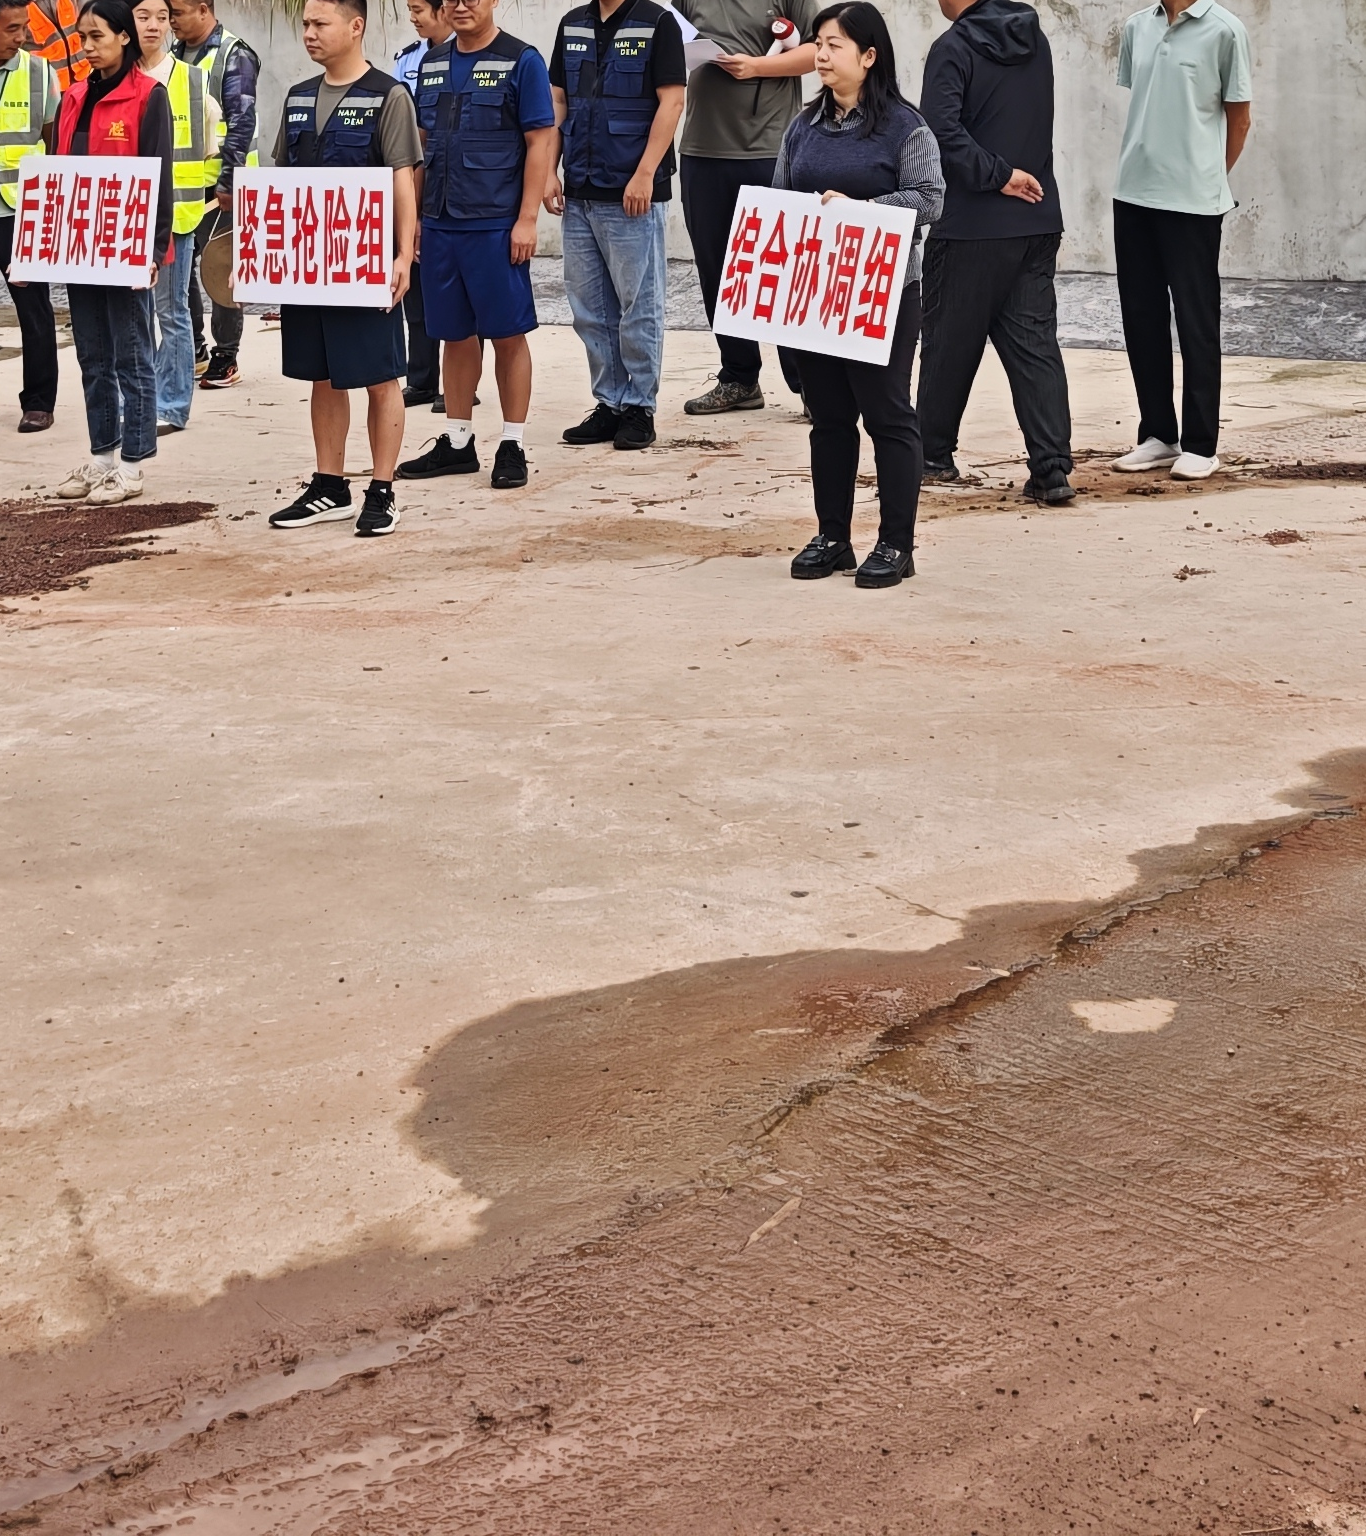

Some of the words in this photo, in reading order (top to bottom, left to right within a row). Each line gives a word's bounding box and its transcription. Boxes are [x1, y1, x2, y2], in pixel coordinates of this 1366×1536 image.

[15, 172, 152, 268] 后勤保障组
[237, 185, 386, 285] 紧急抢险组
[721, 207, 901, 340] 综合协调组
